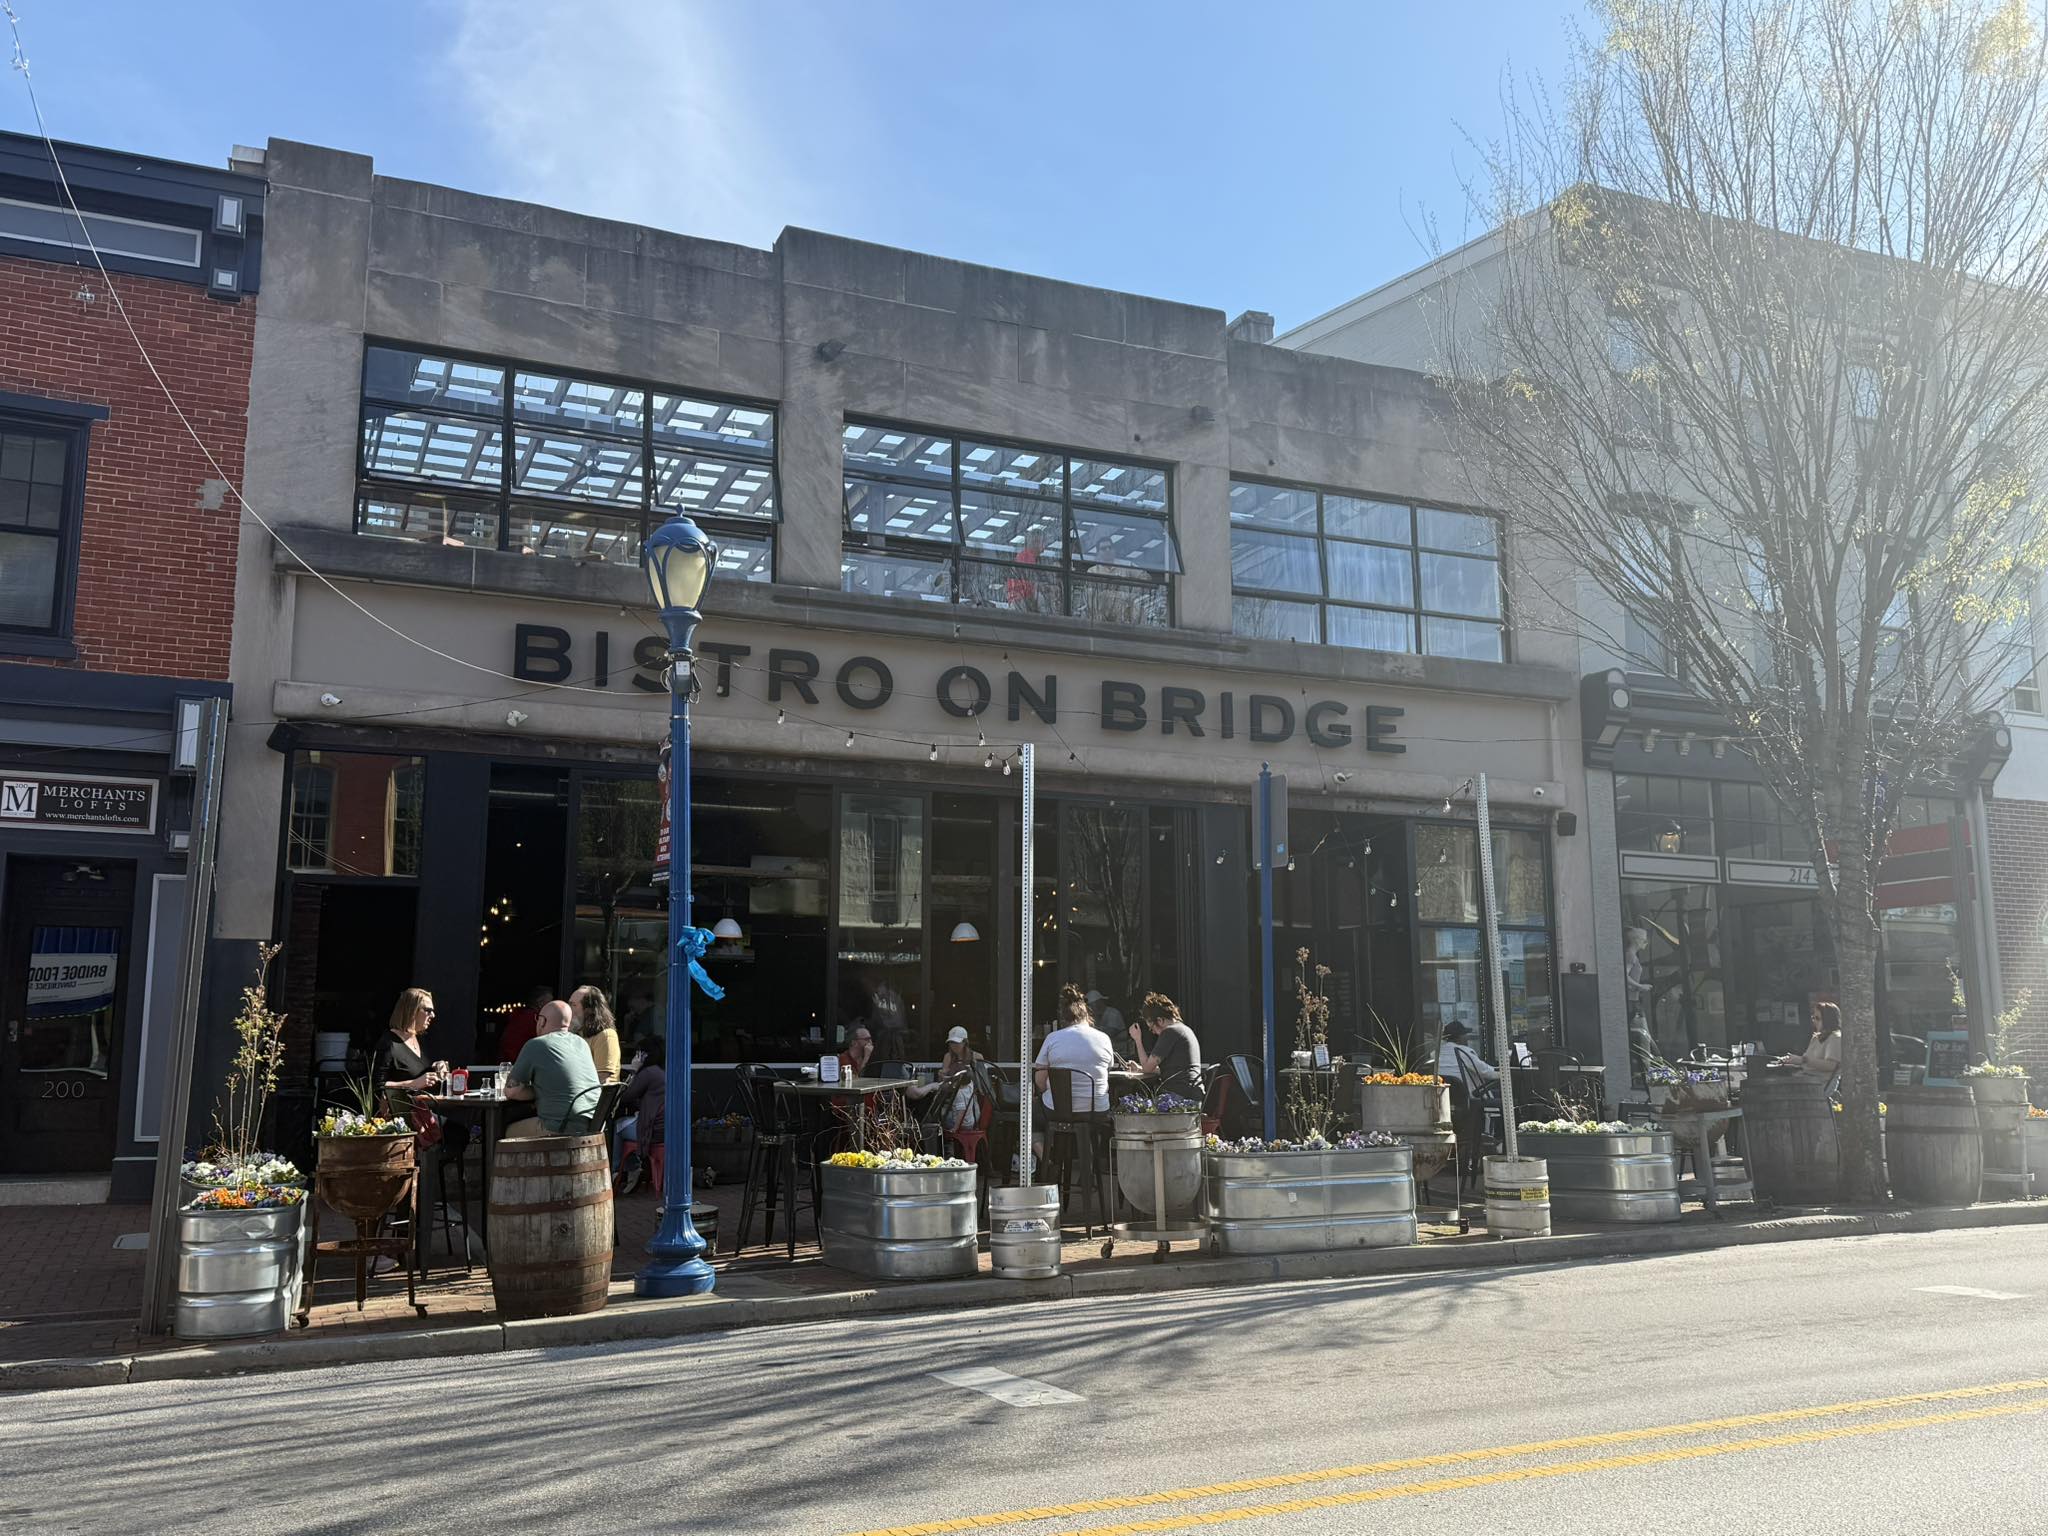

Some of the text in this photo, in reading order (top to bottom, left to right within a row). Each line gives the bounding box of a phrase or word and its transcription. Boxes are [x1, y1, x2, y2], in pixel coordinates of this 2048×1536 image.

[514, 622, 1406, 754] BISTRO ON BRIDGE
[2, 785, 37, 812] M
[43, 786, 146, 801] MERCHANTS
[60, 798, 126, 810] LOFTS
[45, 812, 140, 823] www.merchantslofts.com
[1789, 868, 1810, 883] 214
[41, 1081, 85, 1098] 200
